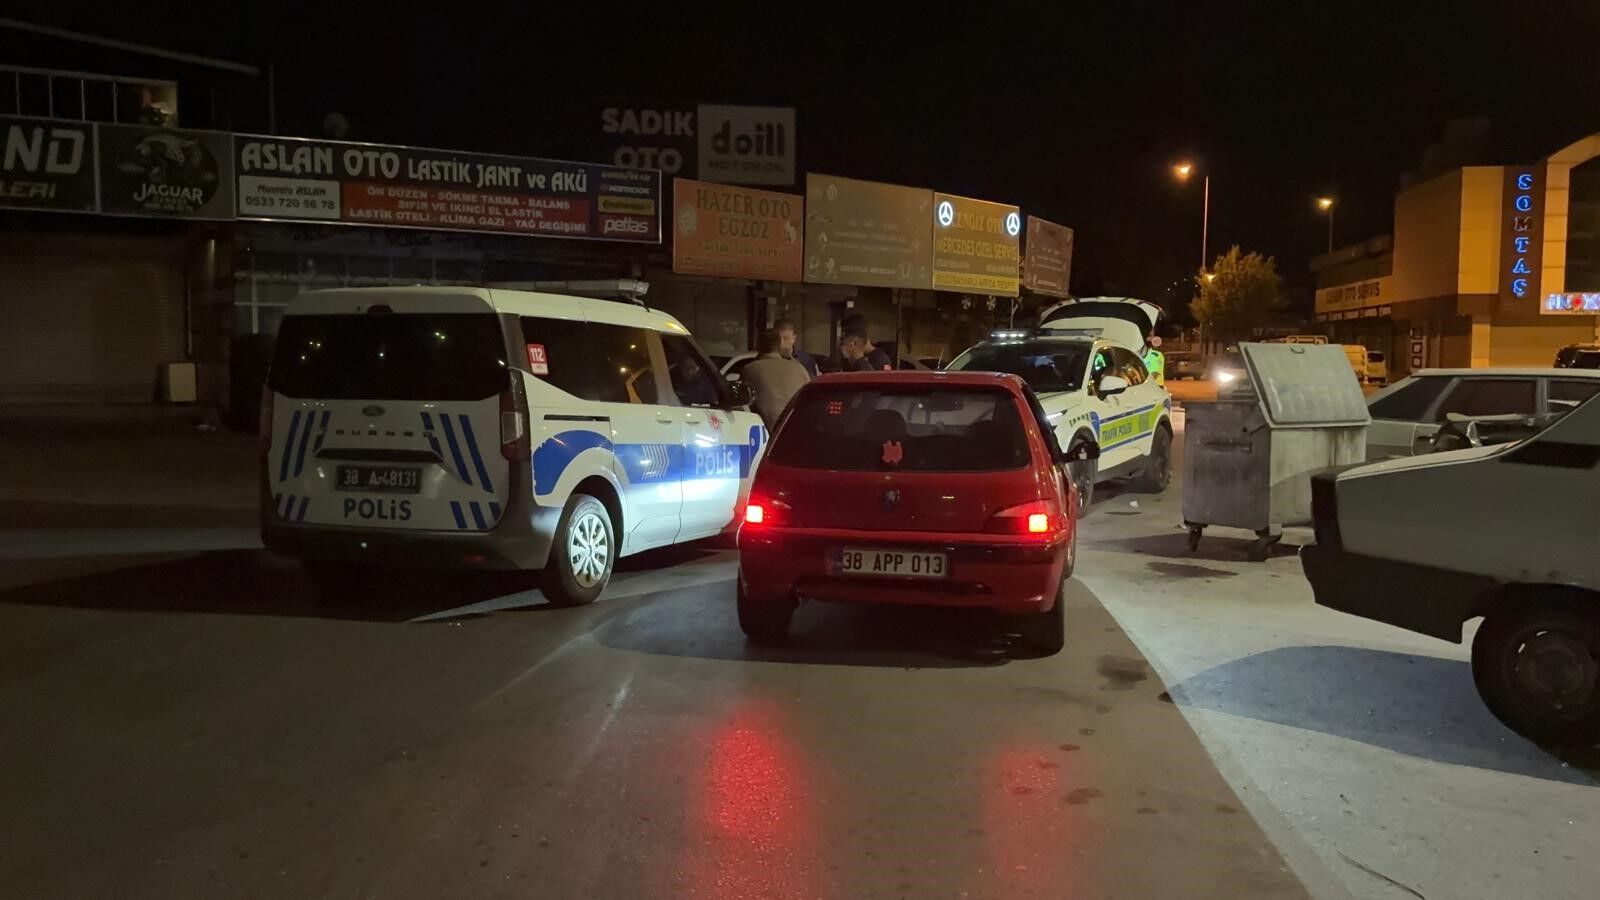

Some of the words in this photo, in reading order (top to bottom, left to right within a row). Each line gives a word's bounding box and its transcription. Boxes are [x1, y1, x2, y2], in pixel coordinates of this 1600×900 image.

[601, 107, 694, 136] SADIK
[710, 120, 786, 156] doill
[241, 142, 333, 175] ASLAN
[343, 149, 400, 179] OTO
[407, 158, 471, 183] LASTİK
[476, 164, 522, 188] JANT
[526, 173, 546, 188] ve
[551, 169, 588, 192] AKÜ
[614, 146, 682, 173] OTO
[133, 183, 203, 205] JAGUAR
[245, 196, 275, 207] 0533
[279, 198, 300, 208] 720
[303, 199, 317, 209] 56
[321, 200, 336, 210] 78
[296, 187, 326, 196] ASLAN
[696, 188, 754, 215] HAZER
[759, 198, 792, 219] OTO
[719, 216, 770, 240] EGZOZ
[530, 347, 545, 362] 112
[343, 469, 358, 485] 38
[843, 552, 862, 570] 38
[873, 553, 904, 572] APP
[911, 555, 943, 574] 013
